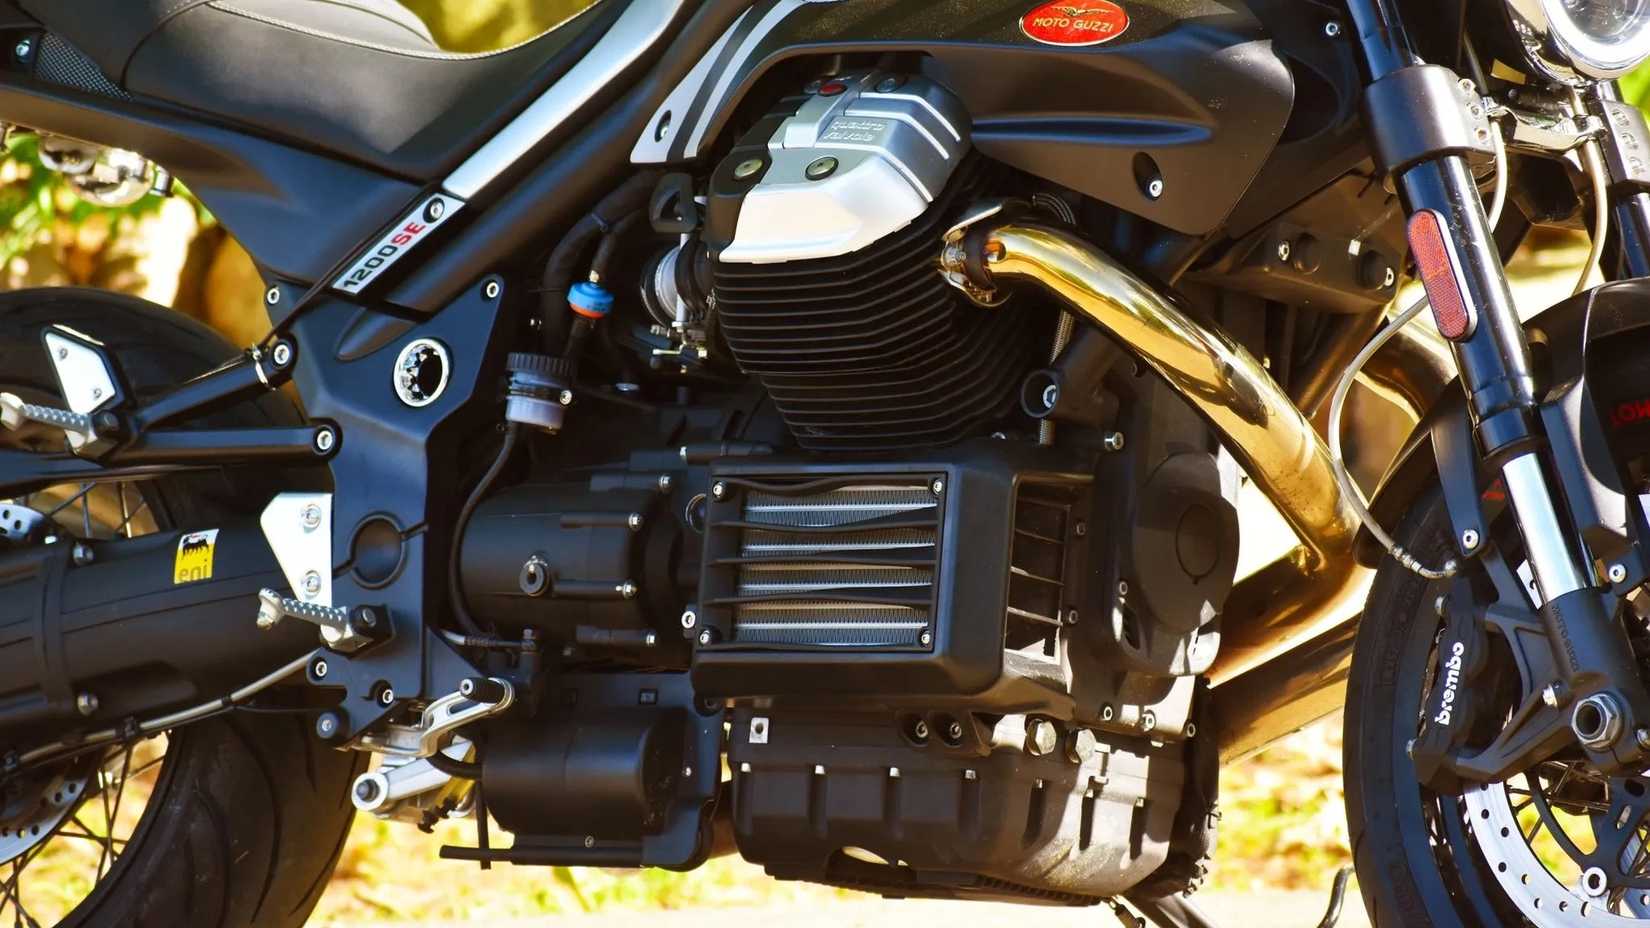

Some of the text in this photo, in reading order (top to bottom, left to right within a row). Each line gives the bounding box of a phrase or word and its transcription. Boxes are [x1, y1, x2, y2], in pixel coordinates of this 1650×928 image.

[1032, 17, 1114, 33] MOTO GUZZI
[343, 222, 426, 287] 1200SE
[179, 558, 208, 581] eni
[1434, 641, 1465, 726] brembo
